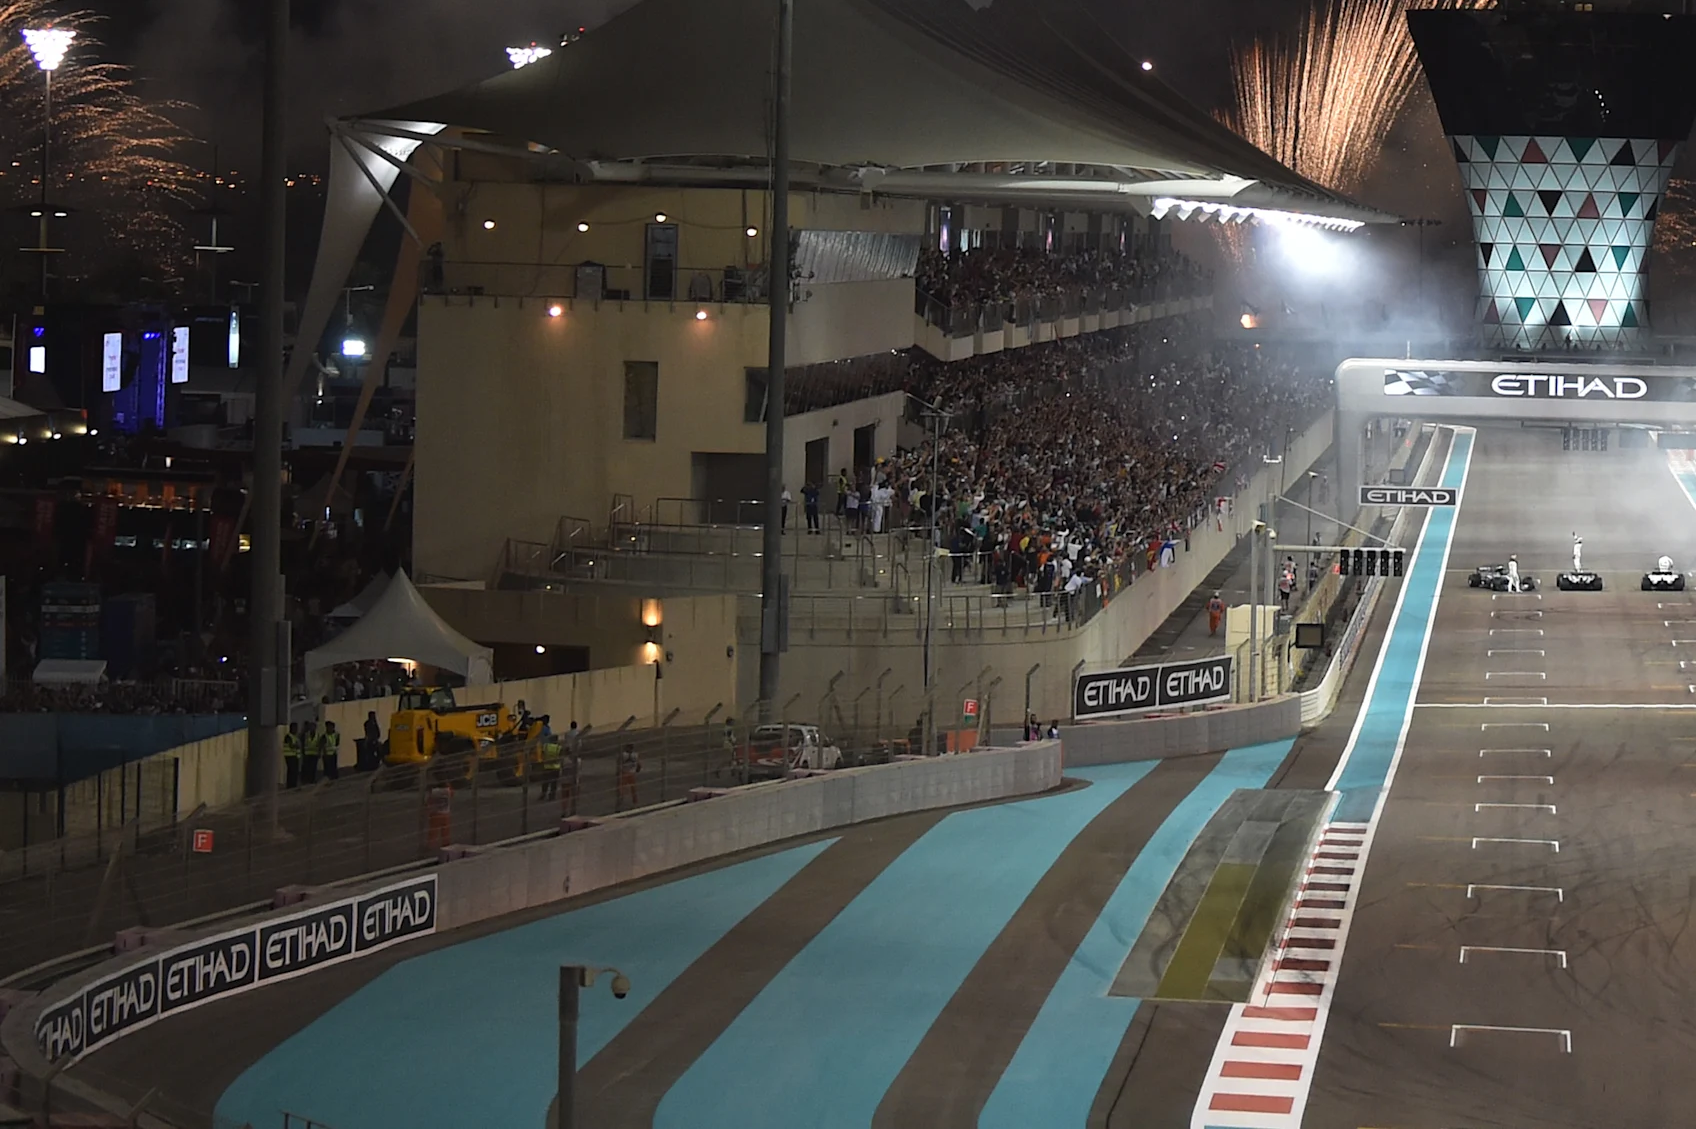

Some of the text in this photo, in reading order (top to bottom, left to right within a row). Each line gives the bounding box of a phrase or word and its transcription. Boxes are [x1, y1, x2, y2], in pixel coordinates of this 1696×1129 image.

[1490, 374, 1648, 400] ETIHAD
[1366, 488, 1450, 505] ETIHAD
[1083, 675, 1151, 707] ETIHAD
[1166, 665, 1225, 698] ETIHAD
[476, 713, 497, 727] JCB
[966, 702, 975, 713] F
[197, 833, 208, 848] F
[362, 889, 431, 942] ETIHAD
[265, 914, 348, 969] ETIHAD
[166, 943, 250, 1001] ETIHAD
[90, 972, 156, 1035] ETIHAD
